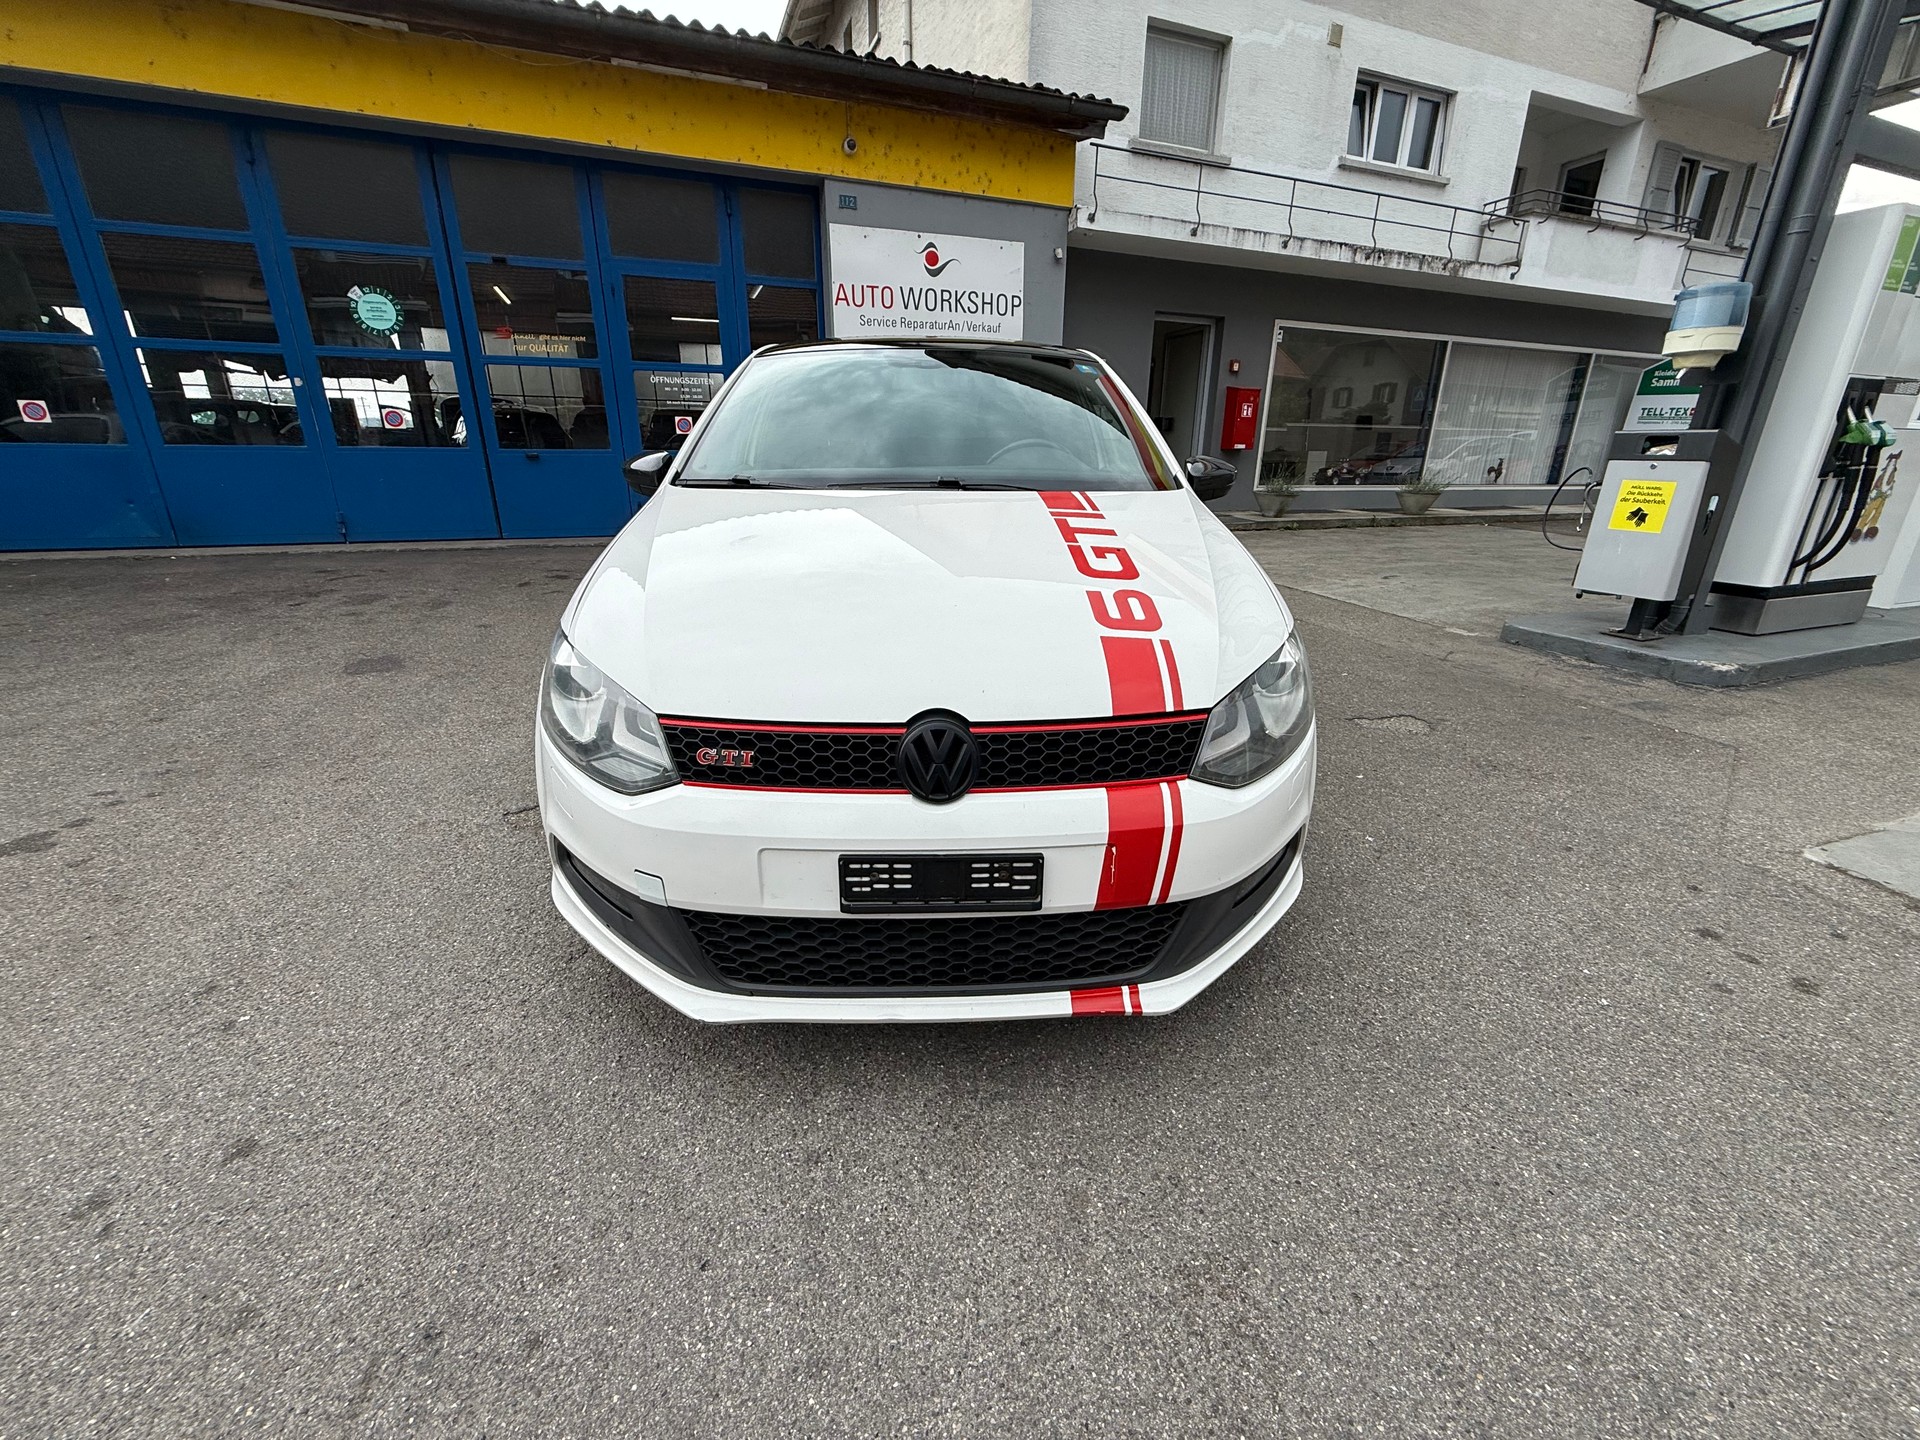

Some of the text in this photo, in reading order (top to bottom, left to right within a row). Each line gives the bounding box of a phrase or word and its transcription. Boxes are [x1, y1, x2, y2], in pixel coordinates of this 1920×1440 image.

[834, 283, 1022, 317] AUTO WORKSHOP
[859, 315, 897, 328] Service
[529, 343, 569, 353] QUALITÄT
[650, 375, 714, 385] ÖFFNUNGSZEITEN
[1641, 407, 1690, 416] TELL-TEX
[1049, 511, 1140, 581] GTI
[696, 747, 755, 768] GTI
